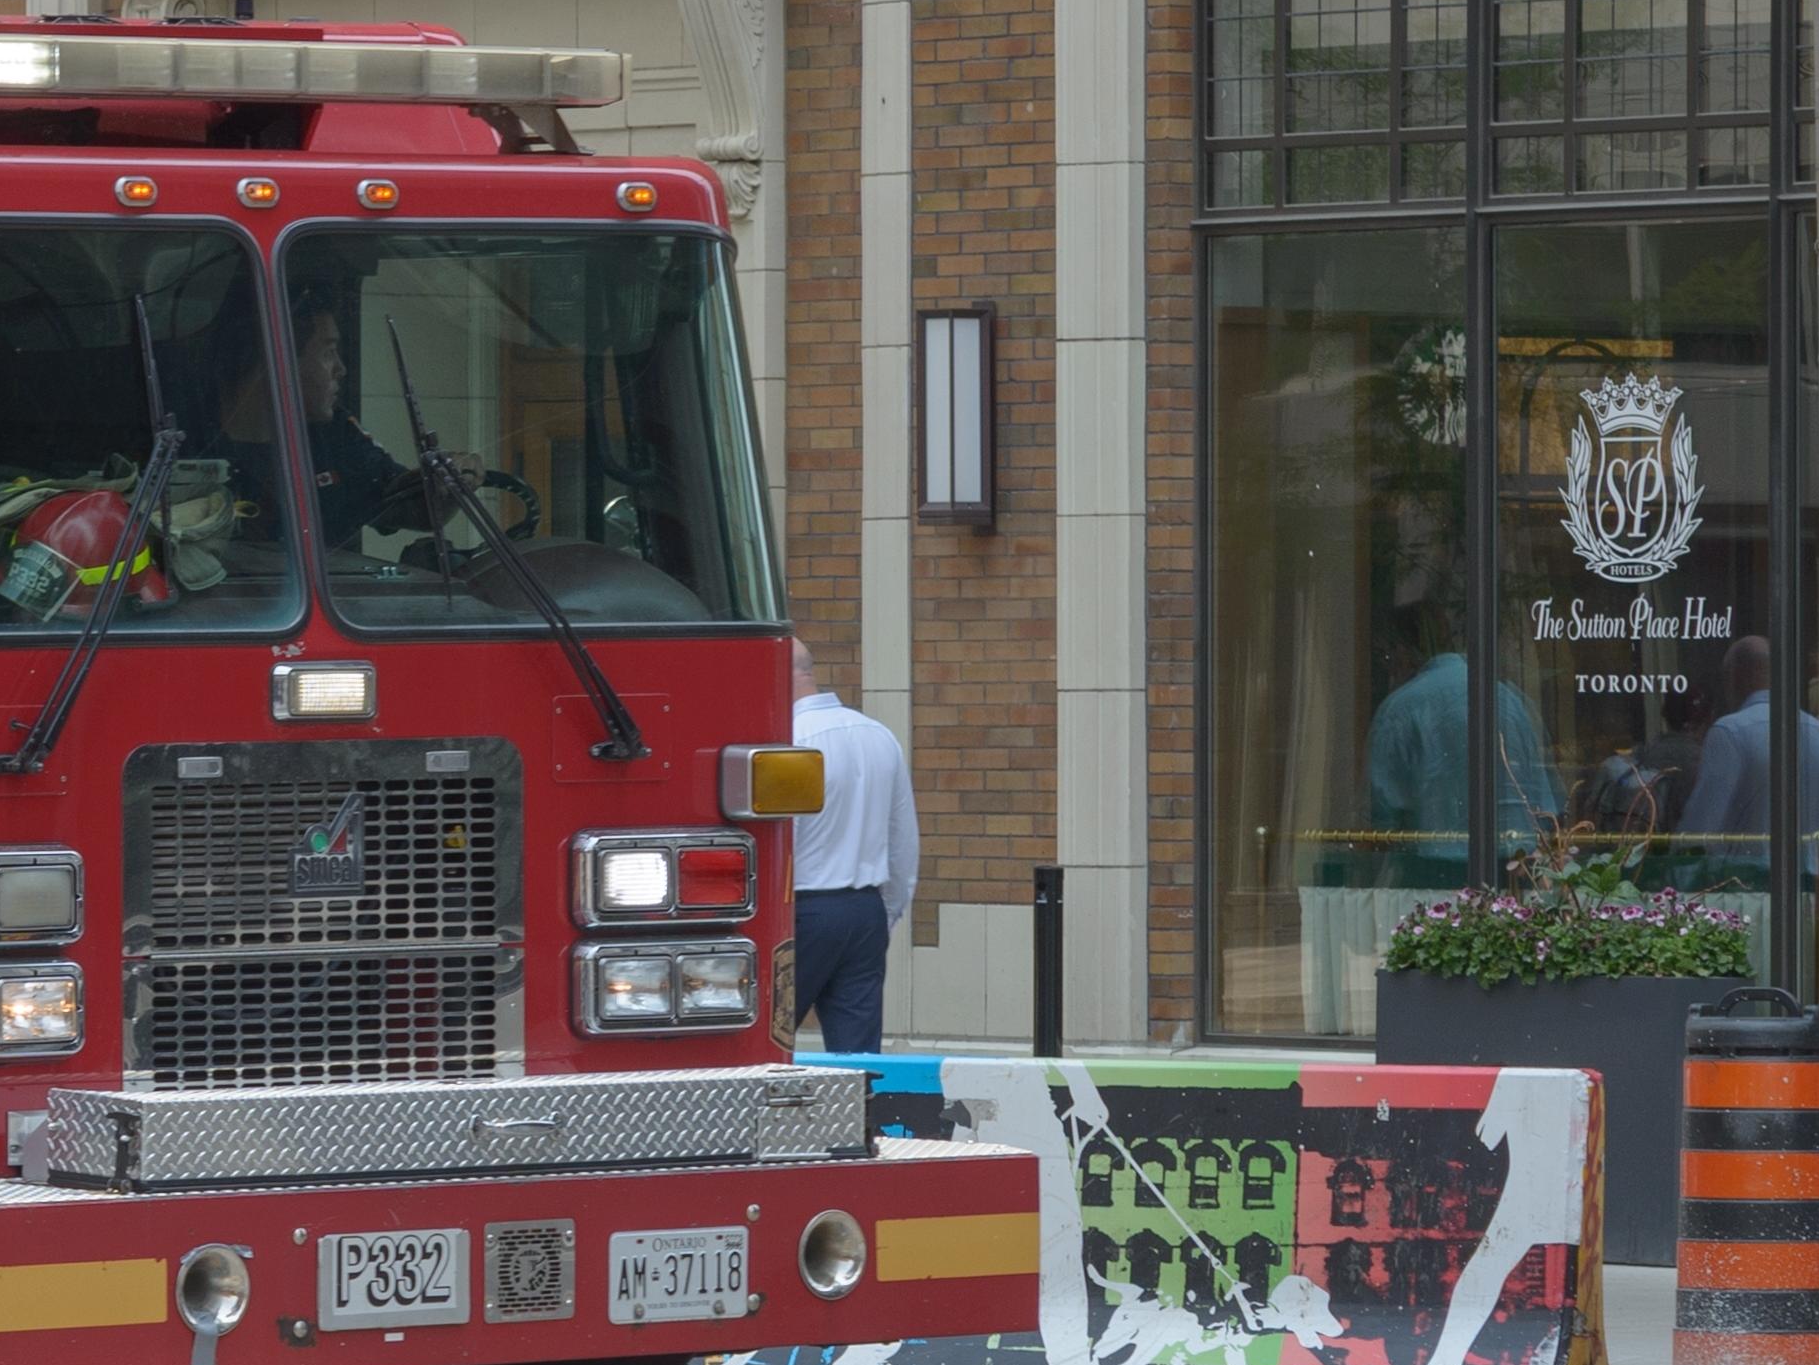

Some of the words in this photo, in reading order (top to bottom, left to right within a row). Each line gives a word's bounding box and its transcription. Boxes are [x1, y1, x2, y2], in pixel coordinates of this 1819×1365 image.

[1610, 564, 1654, 577] HOTELS
[1531, 596, 1565, 641] The
[1567, 598, 1626, 642] Sutton
[1629, 592, 1680, 641] Place
[1681, 596, 1733, 641] Hotel
[1575, 674, 1689, 694] TORONTO
[336, 1233, 453, 1309] P332
